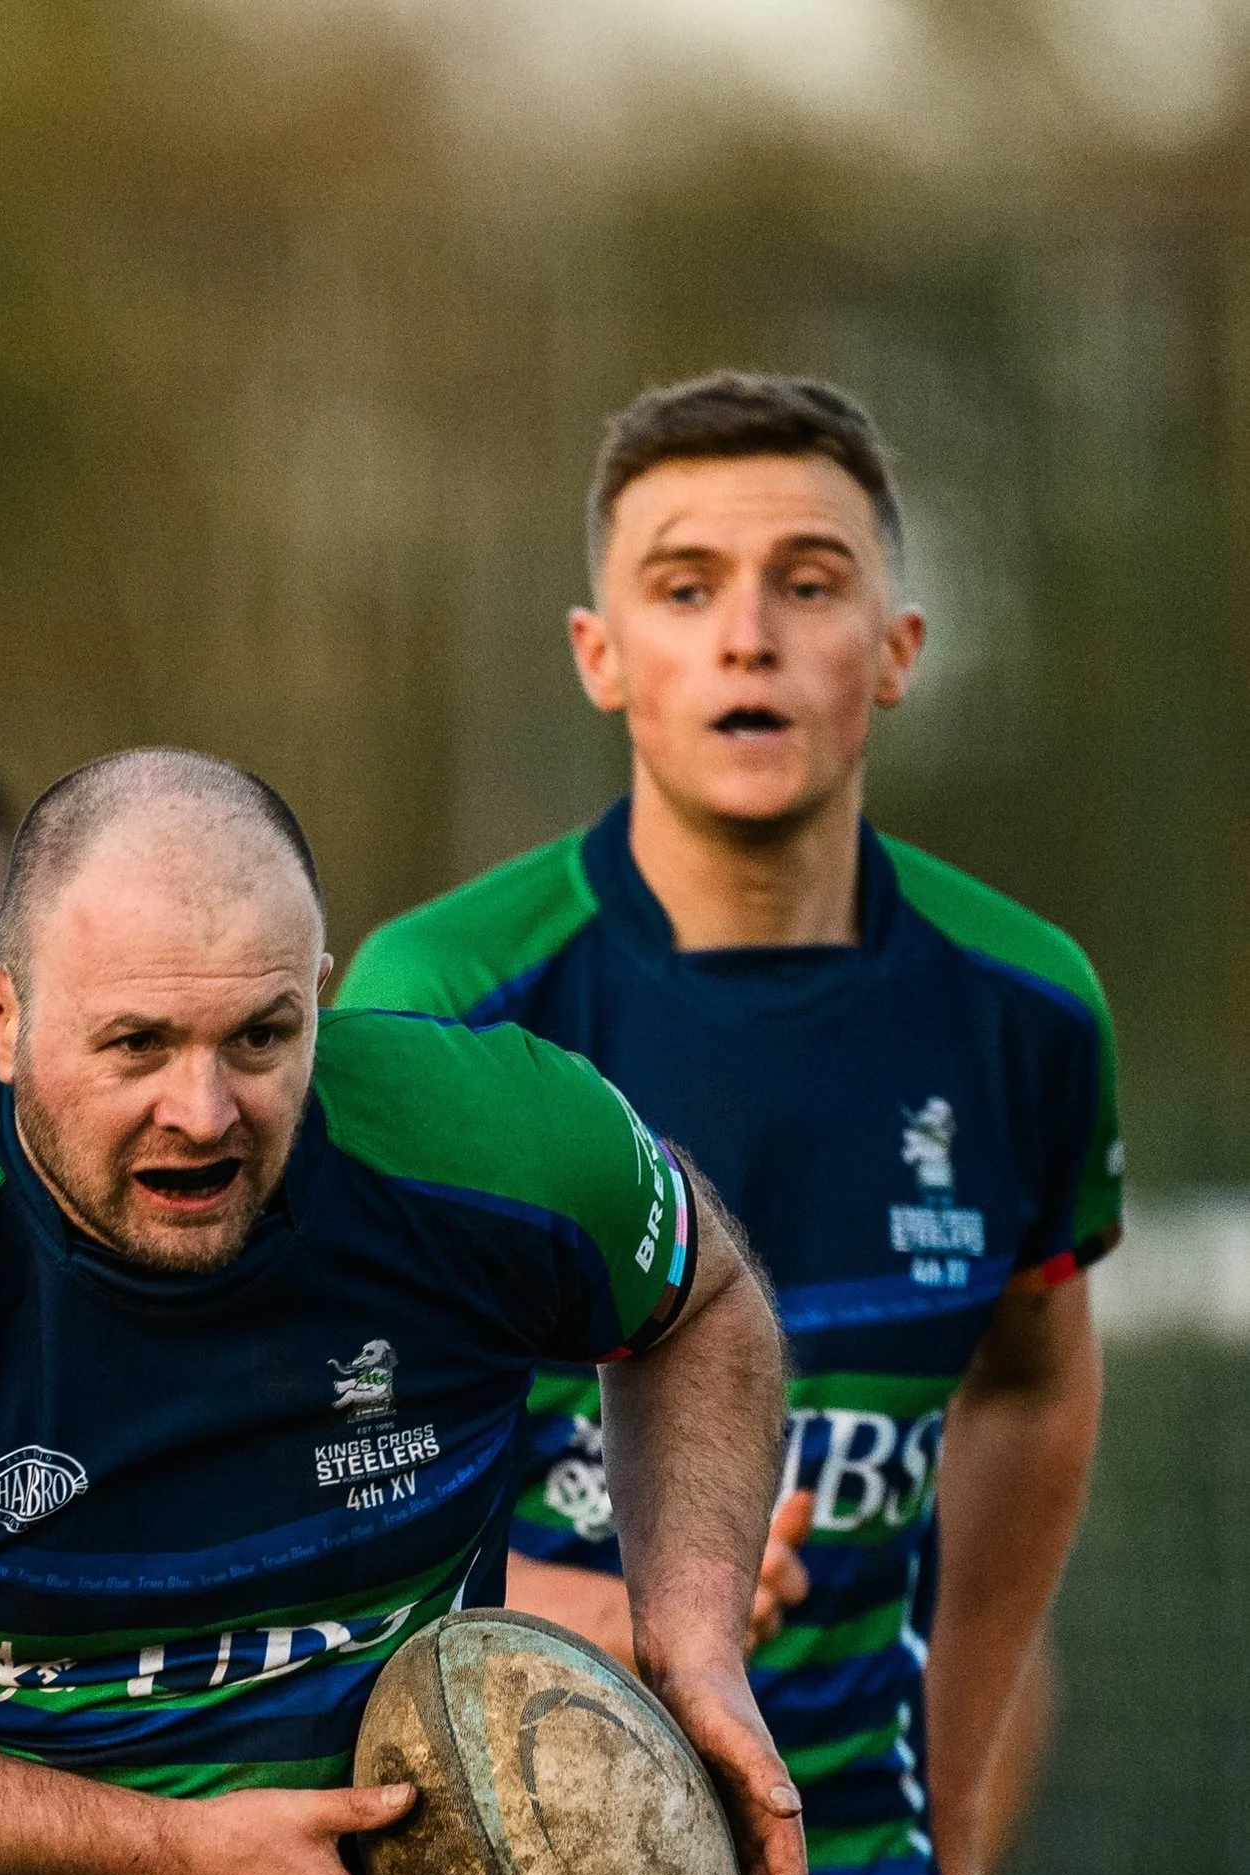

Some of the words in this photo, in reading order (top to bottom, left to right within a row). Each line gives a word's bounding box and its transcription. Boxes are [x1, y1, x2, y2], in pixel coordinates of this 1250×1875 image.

[314, 1438, 371, 1462] KINGS
[377, 1424, 435, 1450] CROSS
[316, 1437, 440, 1481] STEELERS
[346, 1482, 385, 1512] 4th
[390, 1470, 416, 1502] XV
